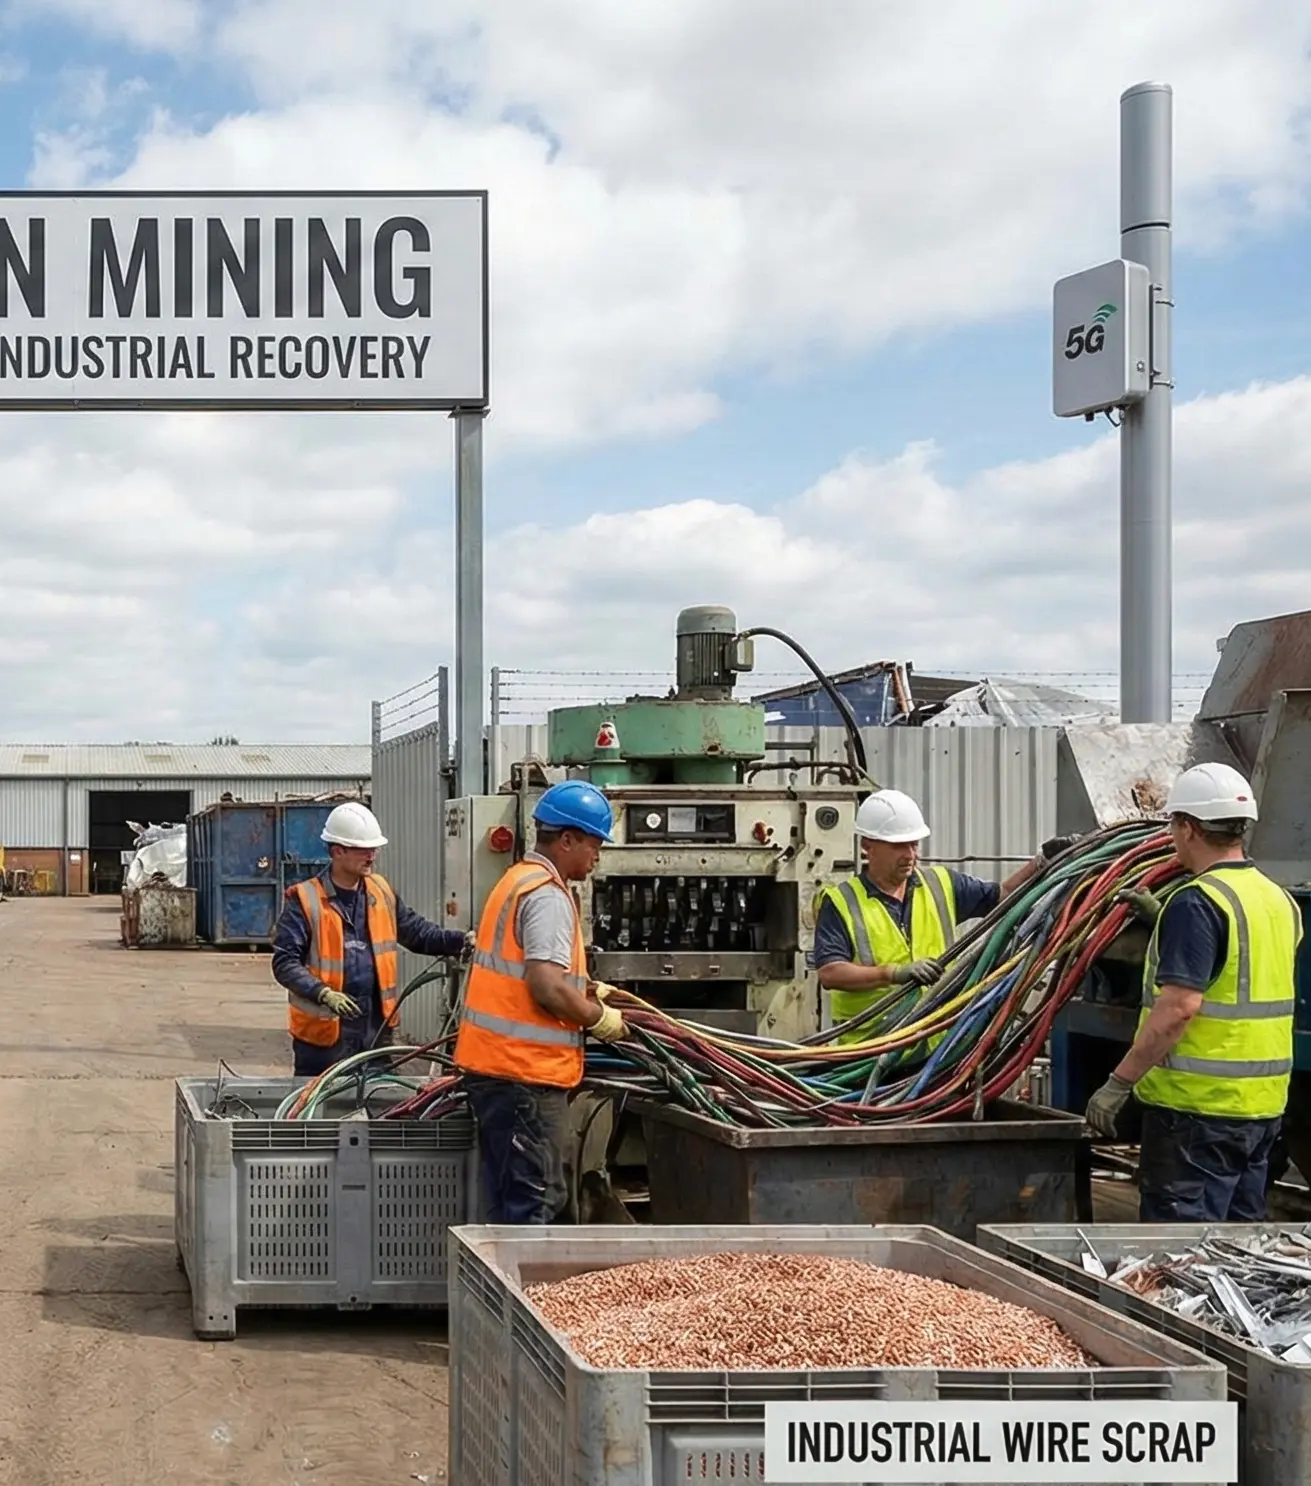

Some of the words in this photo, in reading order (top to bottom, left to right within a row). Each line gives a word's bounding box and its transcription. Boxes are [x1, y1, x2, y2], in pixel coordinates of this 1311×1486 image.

[88, 216, 431, 319] MINING
[230, 335, 431, 379] RECOVERY
[1064, 323, 1106, 360] 5G
